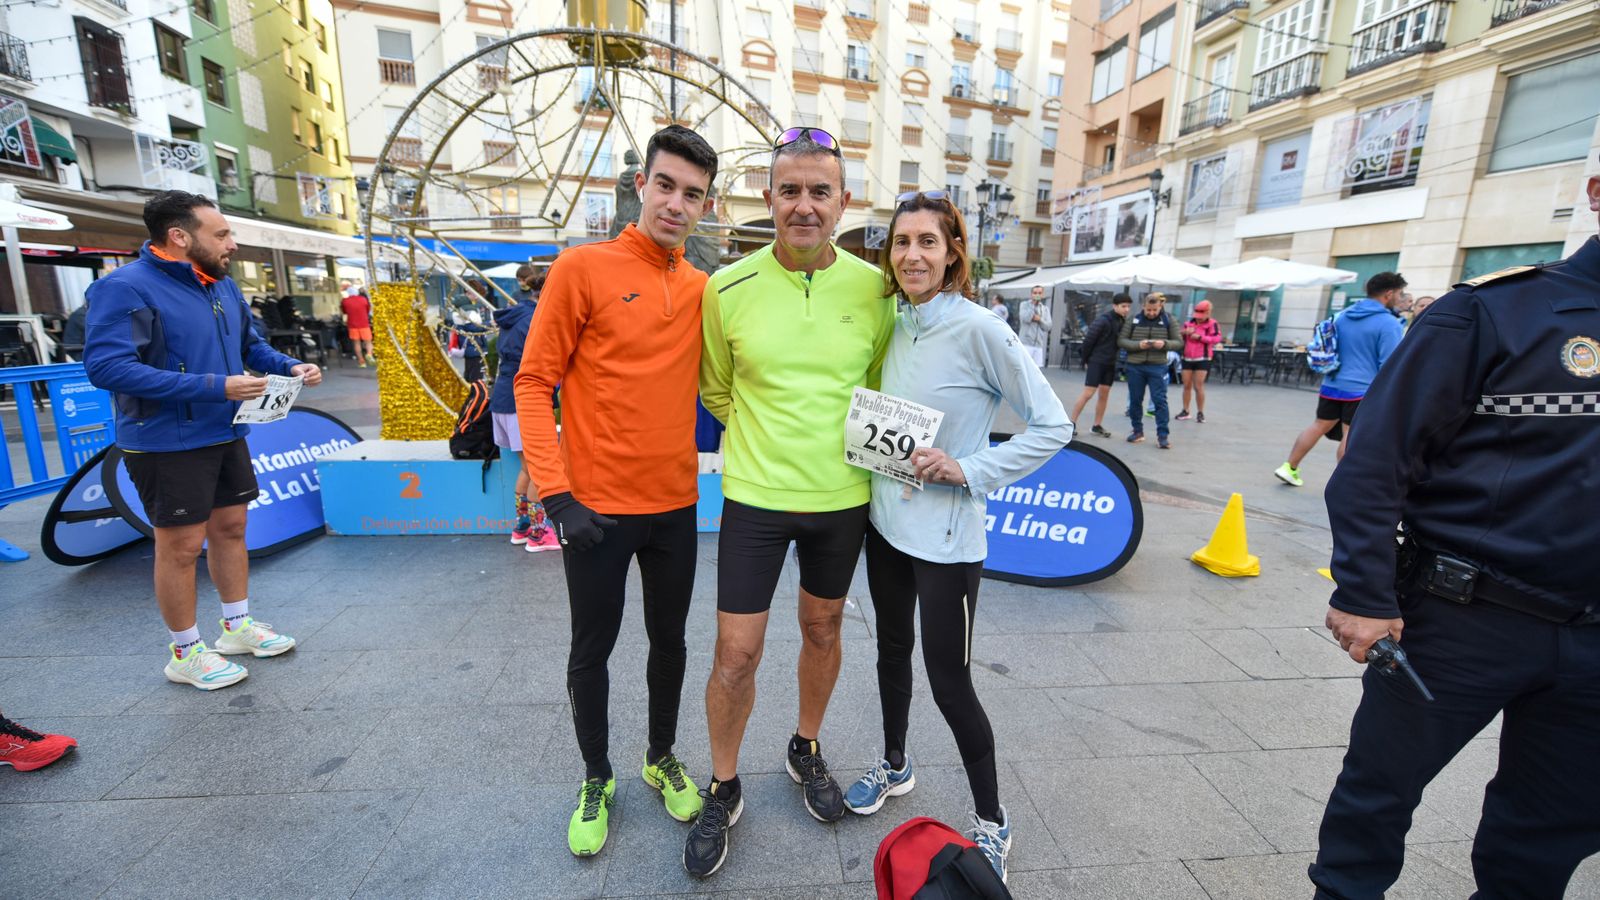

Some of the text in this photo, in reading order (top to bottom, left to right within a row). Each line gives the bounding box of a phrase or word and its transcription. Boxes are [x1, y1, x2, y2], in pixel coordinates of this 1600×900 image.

[258, 393, 292, 409] 188
[863, 423, 916, 461] 259
[270, 480, 304, 501] La
[400, 471, 422, 499] 2
[361, 515, 449, 533] Delegación
[453, 516, 472, 529] de
[1001, 512, 1088, 545] Línea
